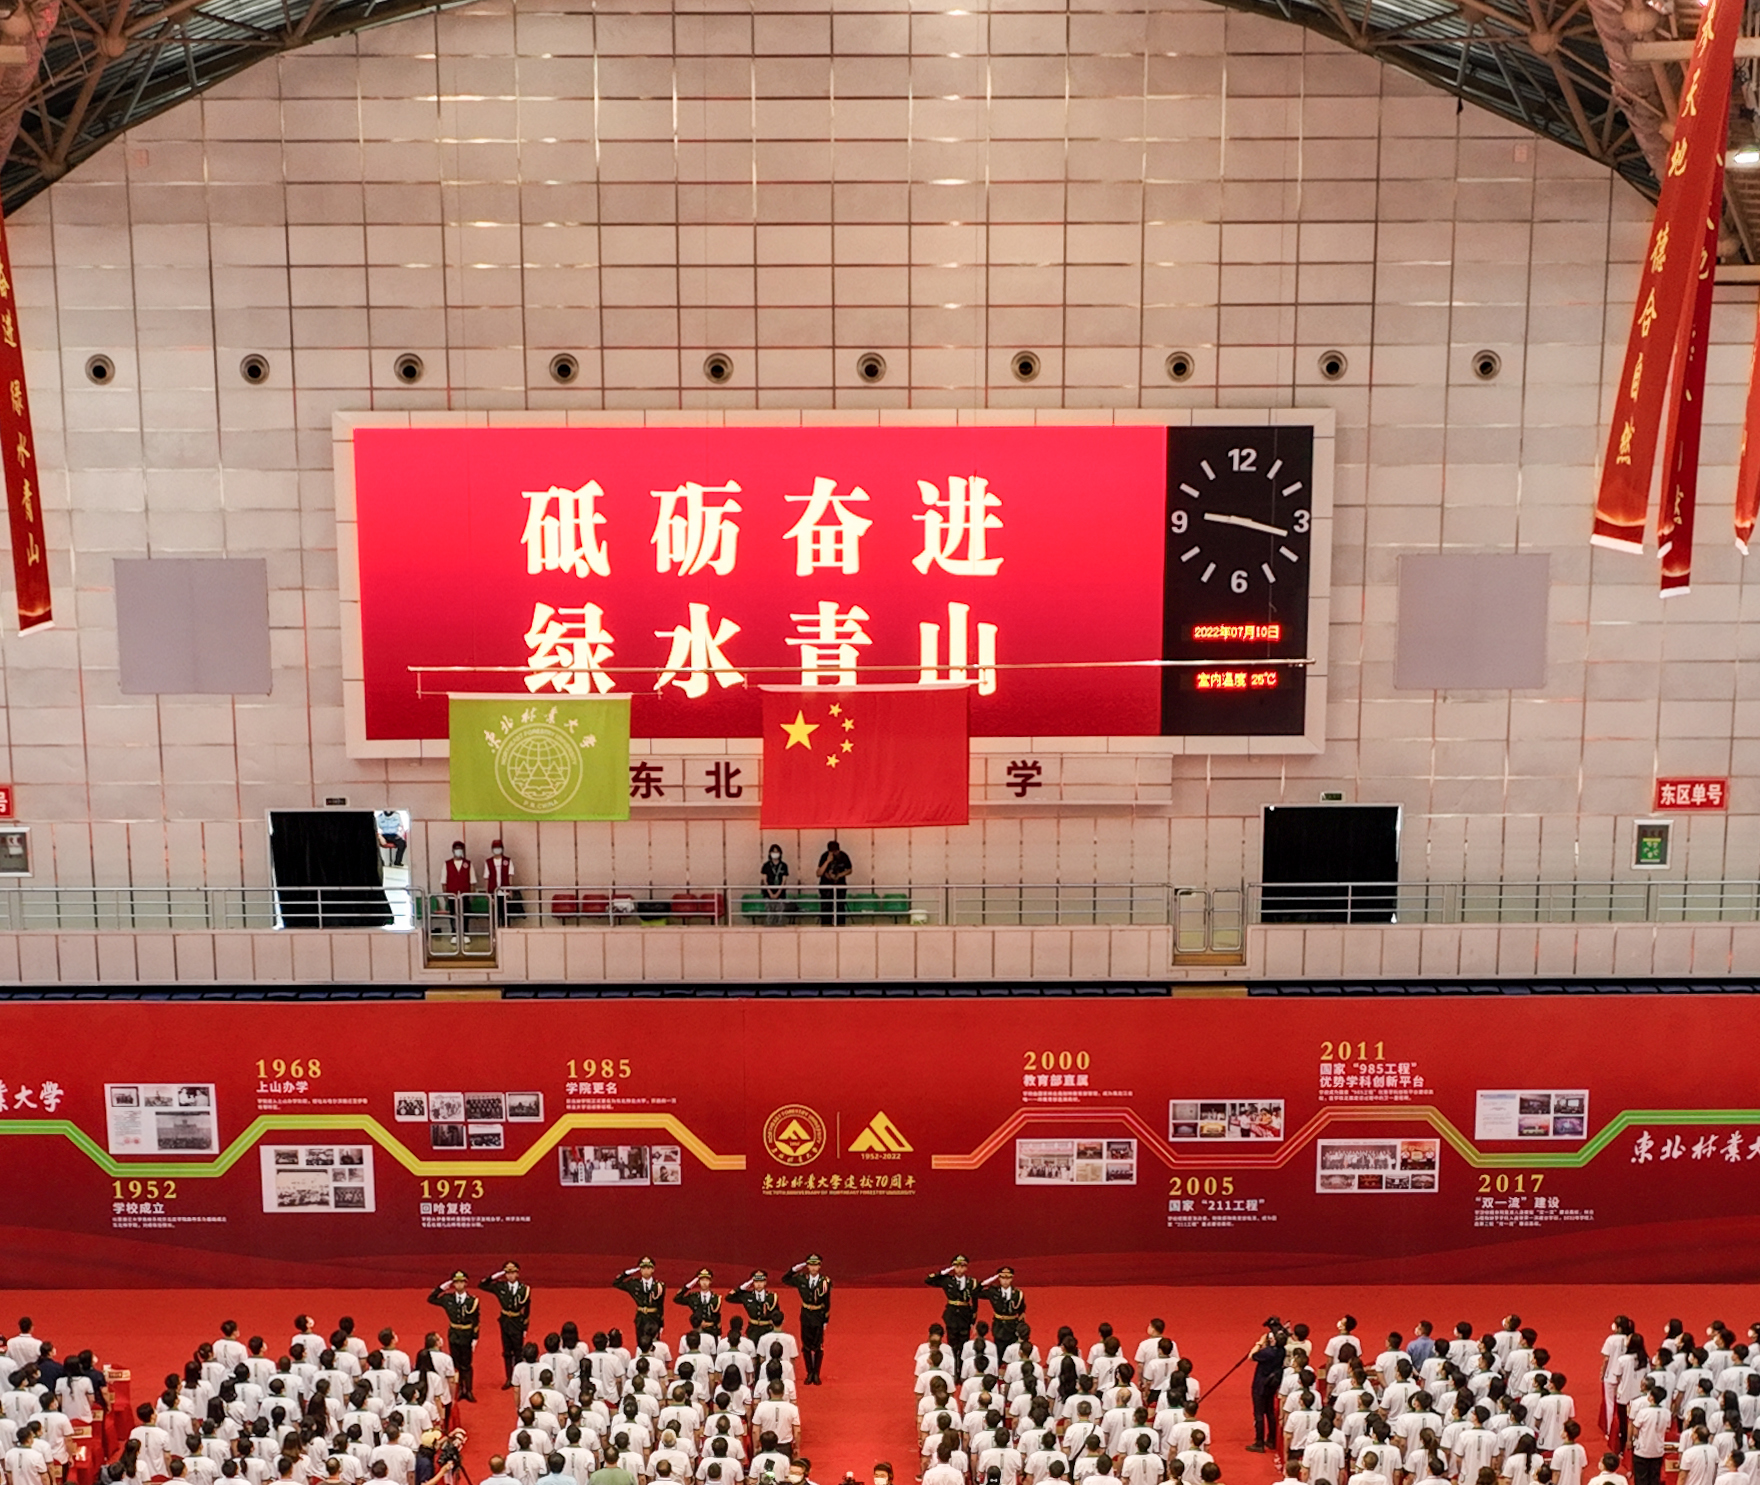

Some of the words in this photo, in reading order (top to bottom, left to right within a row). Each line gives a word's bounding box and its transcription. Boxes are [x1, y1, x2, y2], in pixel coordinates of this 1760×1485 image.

[1616, 222, 1670, 464] 德合自然
[1227, 448, 1257, 472] 12
[11, 380, 39, 565] 绿水青山
[520, 477, 1005, 578] 砥砺奋进
[1171, 510, 1189, 534] 9
[1293, 509, 1311, 533] 3
[1230, 570, 1249, 593] 6
[524, 601, 1000, 700] 绿水青山
[1660, 783, 1723, 806] 东区单号
[1023, 1051, 1090, 1071] 2000
[1320, 1041, 1385, 1061] 2011
[255, 1058, 321, 1078] 1968
[567, 1058, 632, 1078] 1985
[256, 1080, 309, 1094] 上山办学
[565, 1081, 618, 1095] 学院更名
[1023, 1074, 1089, 1087] 教育部直属
[1319, 1075, 1425, 1088] 优势学科创新平台
[861, 1152, 902, 1160] 1952-2022
[112, 1180, 178, 1199] 1952
[420, 1179, 485, 1199] 1973
[1168, 1176, 1235, 1195] 2005
[1478, 1174, 1545, 1193] 2017
[112, 1202, 166, 1215] 学校成立
